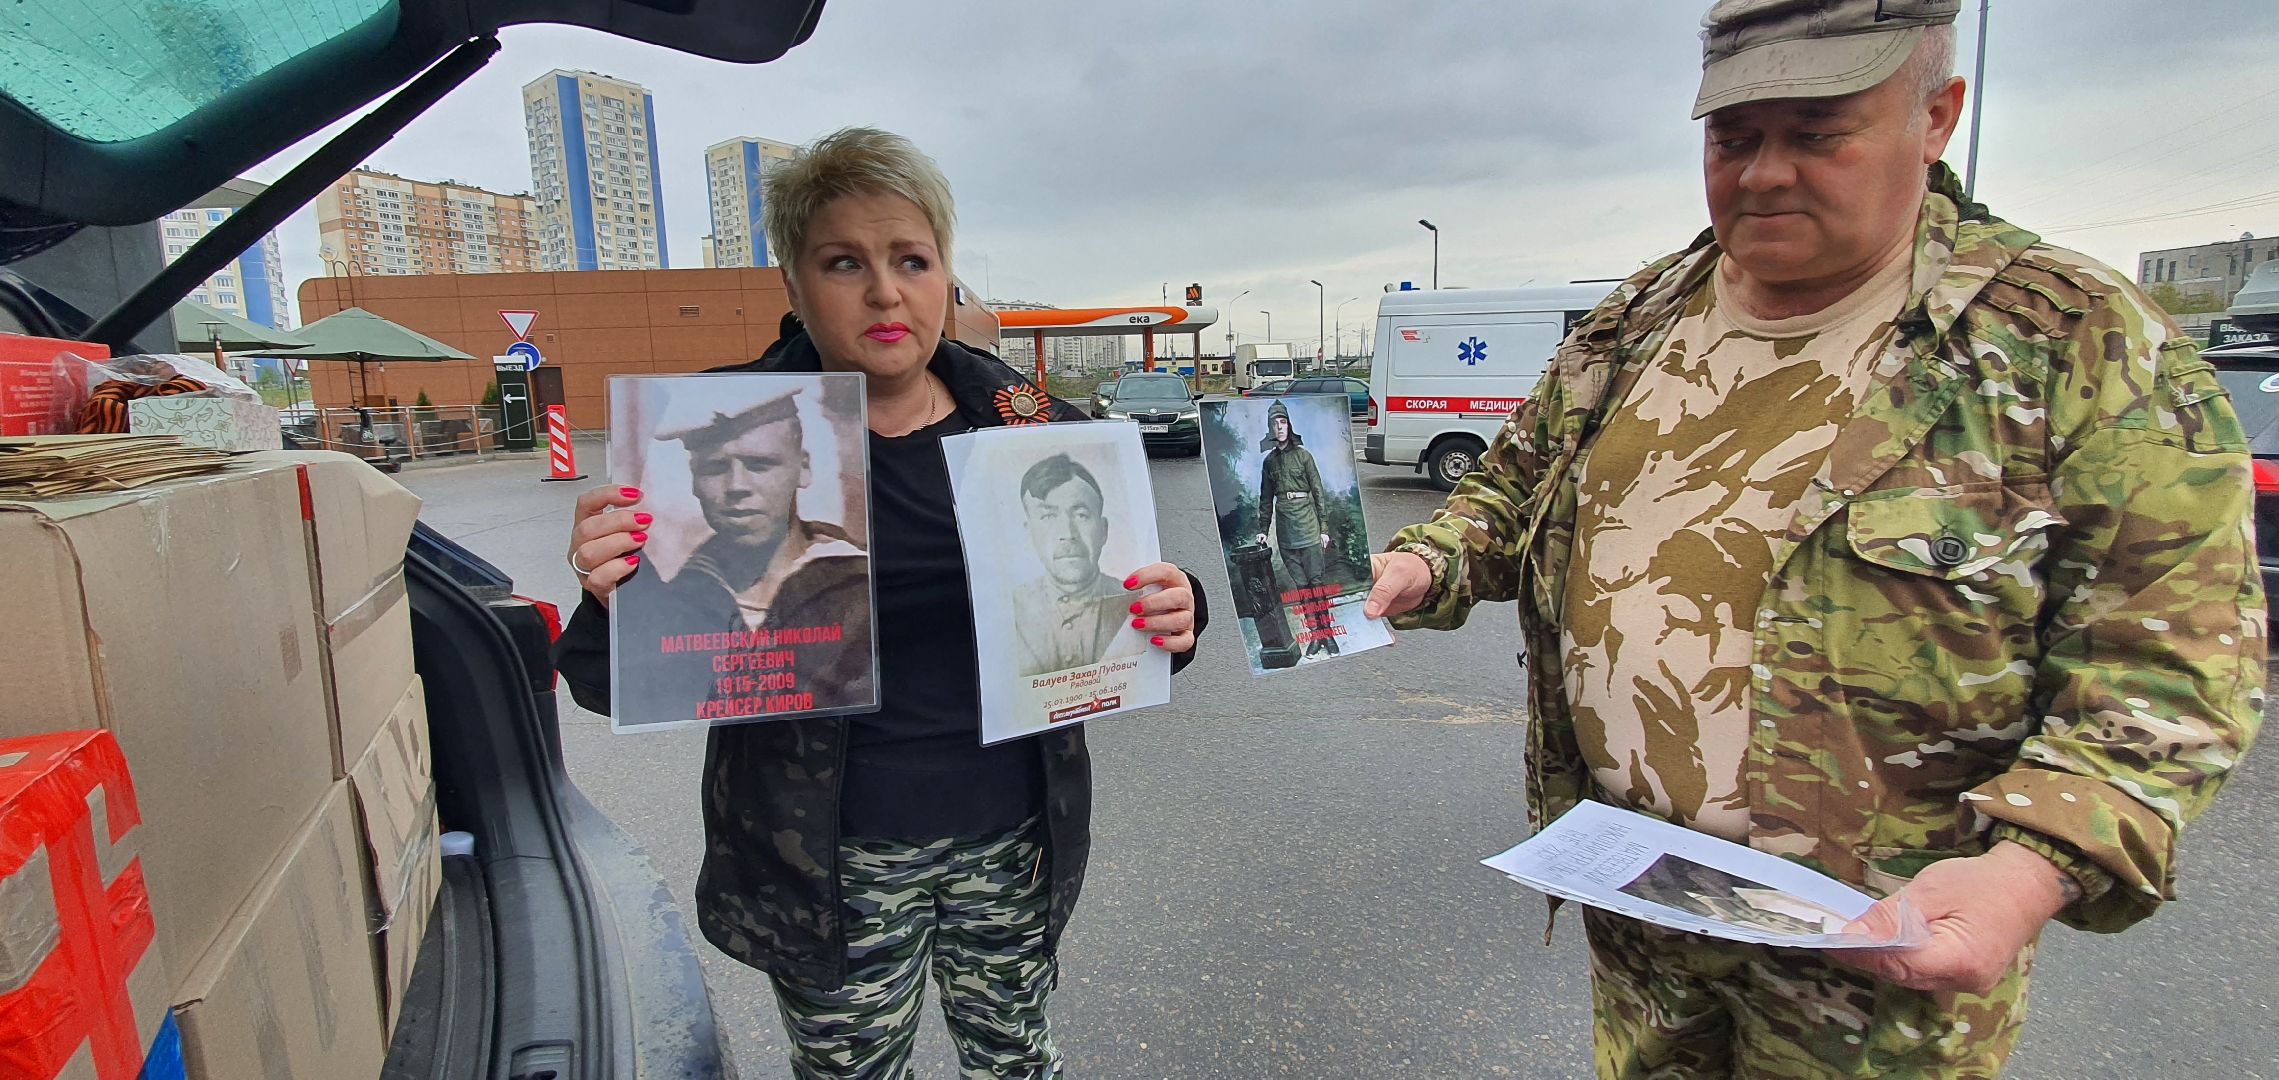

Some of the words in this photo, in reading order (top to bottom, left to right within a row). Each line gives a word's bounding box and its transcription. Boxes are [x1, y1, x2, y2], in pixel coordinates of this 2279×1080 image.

[2223, 333, 2270, 343] ЗАКАЗА
[496, 364, 524, 372] ВЫЕЗД
[1405, 399, 1447, 409] СКОРАЯ
[661, 629, 770, 653] МАТВЕЕВСКИЙ
[774, 623, 842, 646] НИКОЛАЙ
[712, 650, 795, 673] СЕРГЕЕВИЧ
[717, 672, 795, 694] 1915-2009
[1032, 675, 1067, 689] Валуев
[1069, 668, 1097, 681] Захар
[1099, 660, 1138, 675] Пудович
[1070, 675, 1101, 689] Рядовой
[696, 697, 763, 719] КРЕЙСЕР
[766, 692, 813, 714] КИРОВ
